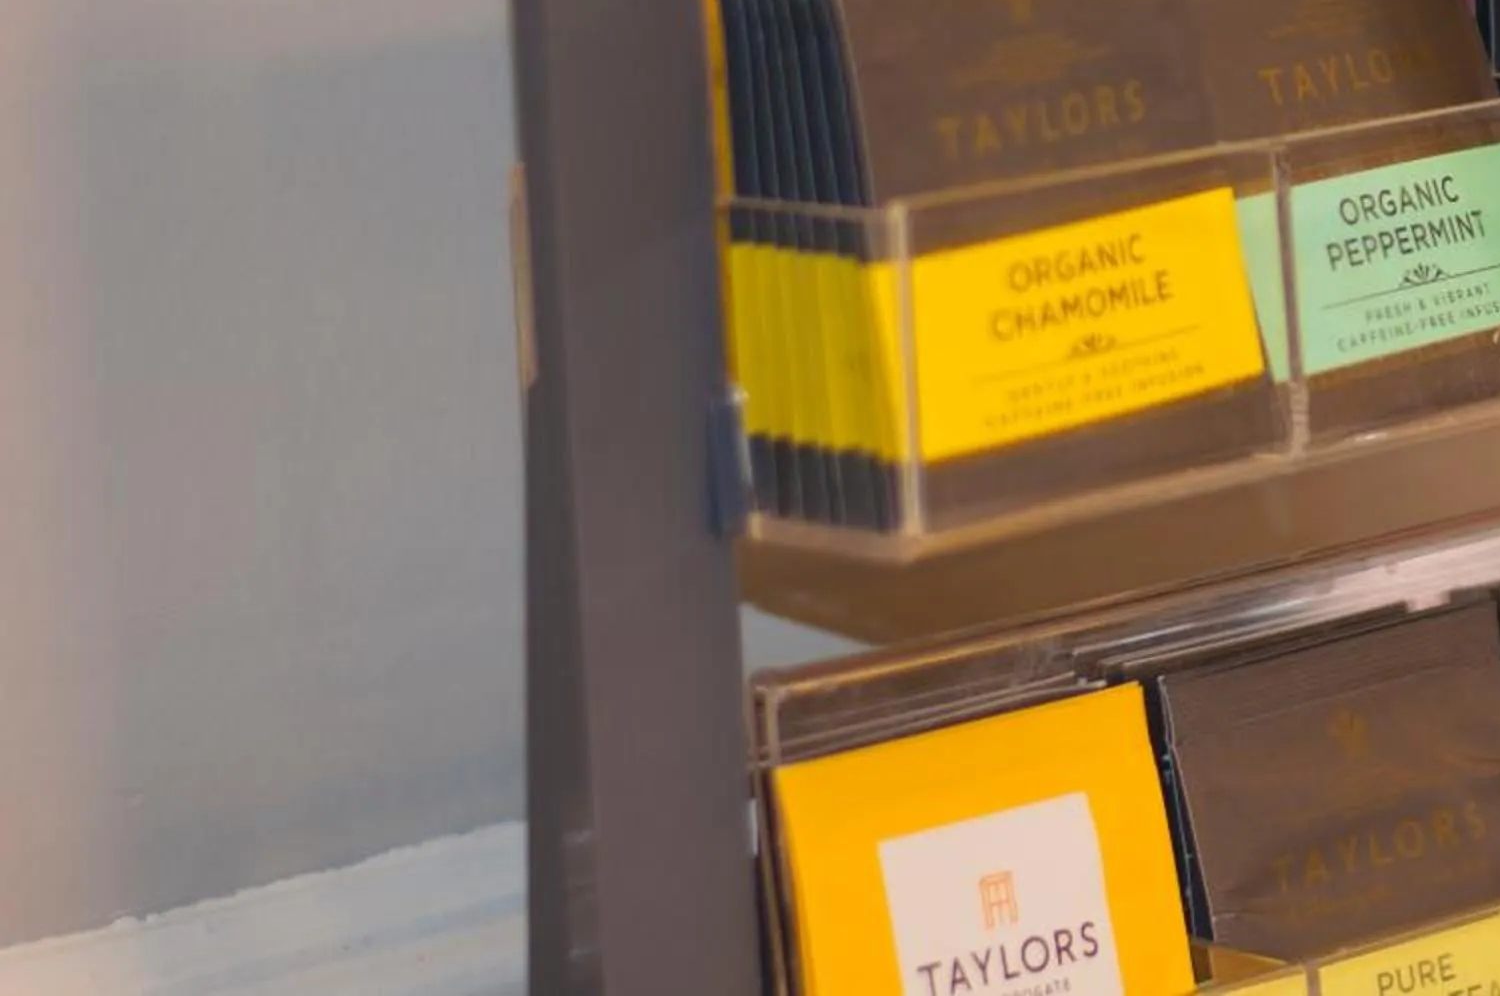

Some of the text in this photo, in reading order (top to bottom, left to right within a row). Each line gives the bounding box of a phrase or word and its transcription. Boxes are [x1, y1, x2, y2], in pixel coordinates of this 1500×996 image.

[1257, 42, 1418, 107] TAYLO
[937, 77, 1147, 160] TAYLORS
[1339, 176, 1459, 225] ORGANIC
[1008, 233, 1145, 294] ORGANIC
[1326, 210, 1486, 272] PEPPERMINT
[989, 269, 1174, 342] CHAMOMILE
[1273, 800, 1488, 894] TAYLORS
[917, 921, 1098, 996] TAYLORS
[1377, 952, 1457, 996] PURE
